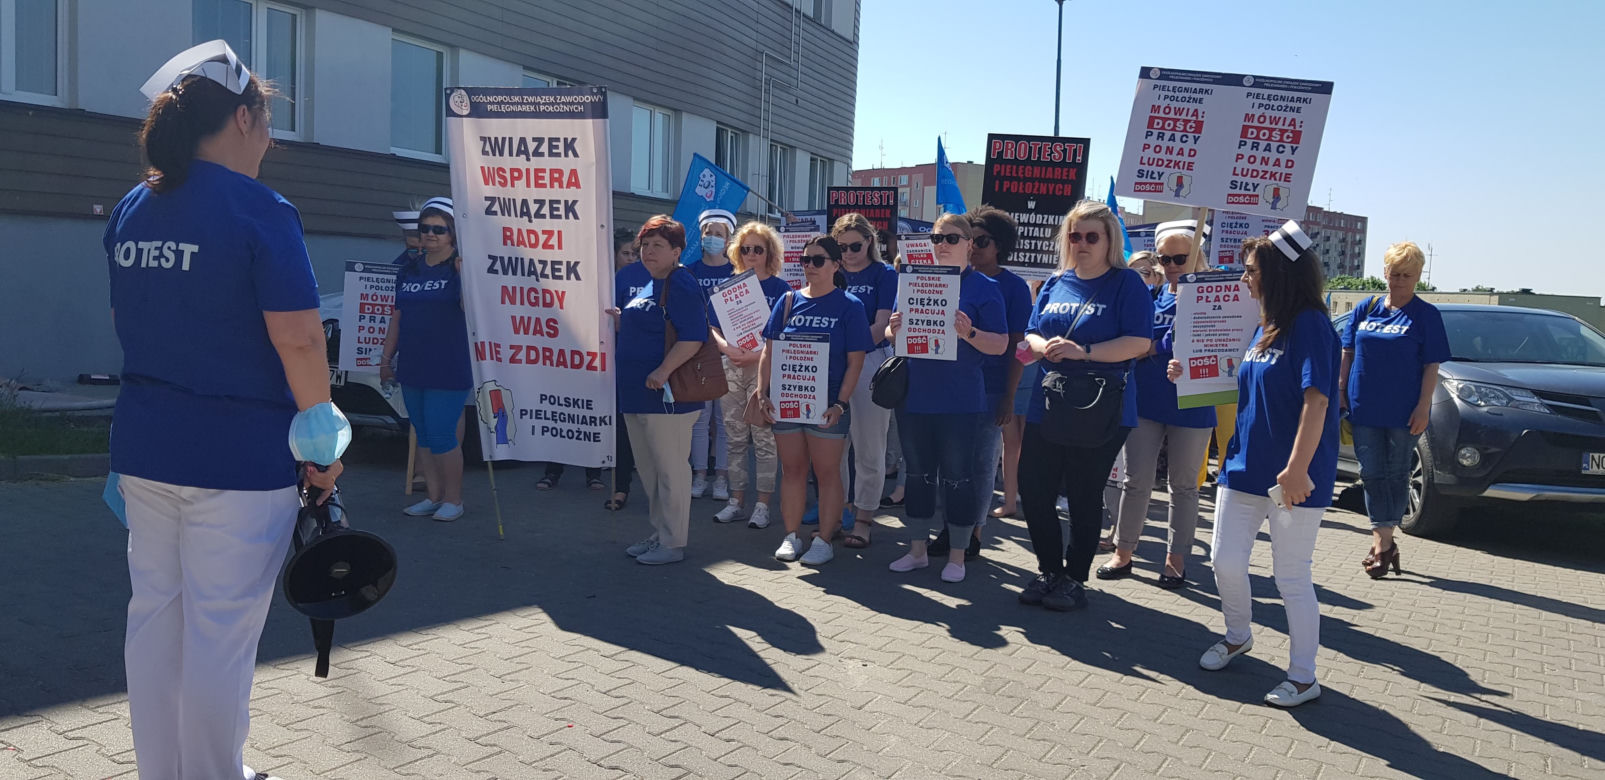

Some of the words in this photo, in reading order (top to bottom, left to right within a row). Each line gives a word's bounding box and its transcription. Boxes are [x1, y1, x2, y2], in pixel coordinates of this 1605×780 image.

[1153, 84, 1213, 97] PIELĘGNIARKI
[471, 94, 522, 103] OGÓLNOPOLSKI
[523, 95, 556, 104] ZWIĄZEK
[556, 95, 604, 103] ZAWODOWY
[1163, 95, 1204, 105] POŁOŻNE
[1246, 91, 1312, 105] PIELĘGNIARKI
[487, 104, 537, 113] PIELĘGNIAREK
[540, 104, 585, 113] POŁOŻNYCH
[1150, 103, 1205, 120] MÓWIĄ:
[1257, 103, 1303, 115] POŁOŻNE
[1153, 118, 1196, 132] DOŚĆ
[1243, 112, 1304, 129] MÓWIĄ:
[1145, 131, 1201, 145] PRACY
[1247, 127, 1294, 143] DOŚĆ
[479, 136, 581, 162] ZWIĄZEK
[991, 139, 1084, 163] PROTEST!
[1142, 143, 1197, 159] PONAD
[1238, 141, 1300, 156] PRACY
[1139, 156, 1195, 172] LUDZKIE
[1235, 154, 1295, 169] PONAD
[480, 165, 582, 190] WSPIERA
[993, 164, 1078, 180] PIELĘGNIAREK
[1136, 169, 1165, 181] SIŁY
[1232, 167, 1293, 183] LUDZKIE
[995, 180, 1000, 192] I
[1003, 180, 1073, 196] POŁOŻNYCH
[1229, 180, 1260, 193] SIŁY
[830, 191, 895, 206] PROTEST!
[1027, 200, 1036, 209] W
[484, 196, 581, 223] ZWIĄZEK
[1010, 211, 1065, 225] EWÓDZKI
[1016, 226, 1052, 238] PITALU
[1221, 221, 1250, 230] CIĘŻKO
[502, 226, 563, 251] RADZI
[486, 254, 582, 283] ZWIĄZEK
[359, 276, 396, 284] PIELĘGNI
[721, 281, 748, 299] GODNA
[1196, 284, 1240, 294] GODNA
[360, 292, 395, 303] MÓWI
[500, 285, 566, 310] NIGDY
[724, 288, 750, 305] PŁACA
[908, 296, 948, 308] CIĘŻKO
[1196, 294, 1240, 304] PŁACA
[365, 304, 392, 315] DOŚ
[909, 307, 946, 317] PRACUJĄ
[359, 314, 390, 323] PRA
[908, 318, 946, 328] SZYBKO
[358, 325, 386, 335] PON
[510, 315, 560, 339] WAS
[907, 327, 946, 336] ODCHODZĄ
[357, 336, 386, 346] LUDZ
[908, 336, 927, 344] DOŚĆ
[474, 341, 503, 363] NIE
[508, 344, 607, 373] ZDRADZI
[1190, 355, 1217, 367] DOŚĆ
[781, 363, 818, 374] CIĘŻKO
[1199, 367, 1209, 378] !!!
[782, 373, 816, 383] PRACUJĄ
[781, 384, 816, 393] SZYBKO
[540, 393, 594, 411] POLSKIE
[781, 392, 816, 401] ODCHODZĄ
[781, 401, 799, 409] DOŚĆ
[520, 408, 613, 427] PIELĘGNIARKI
[531, 424, 536, 437] I
[541, 423, 602, 444] POŁOŻNE
